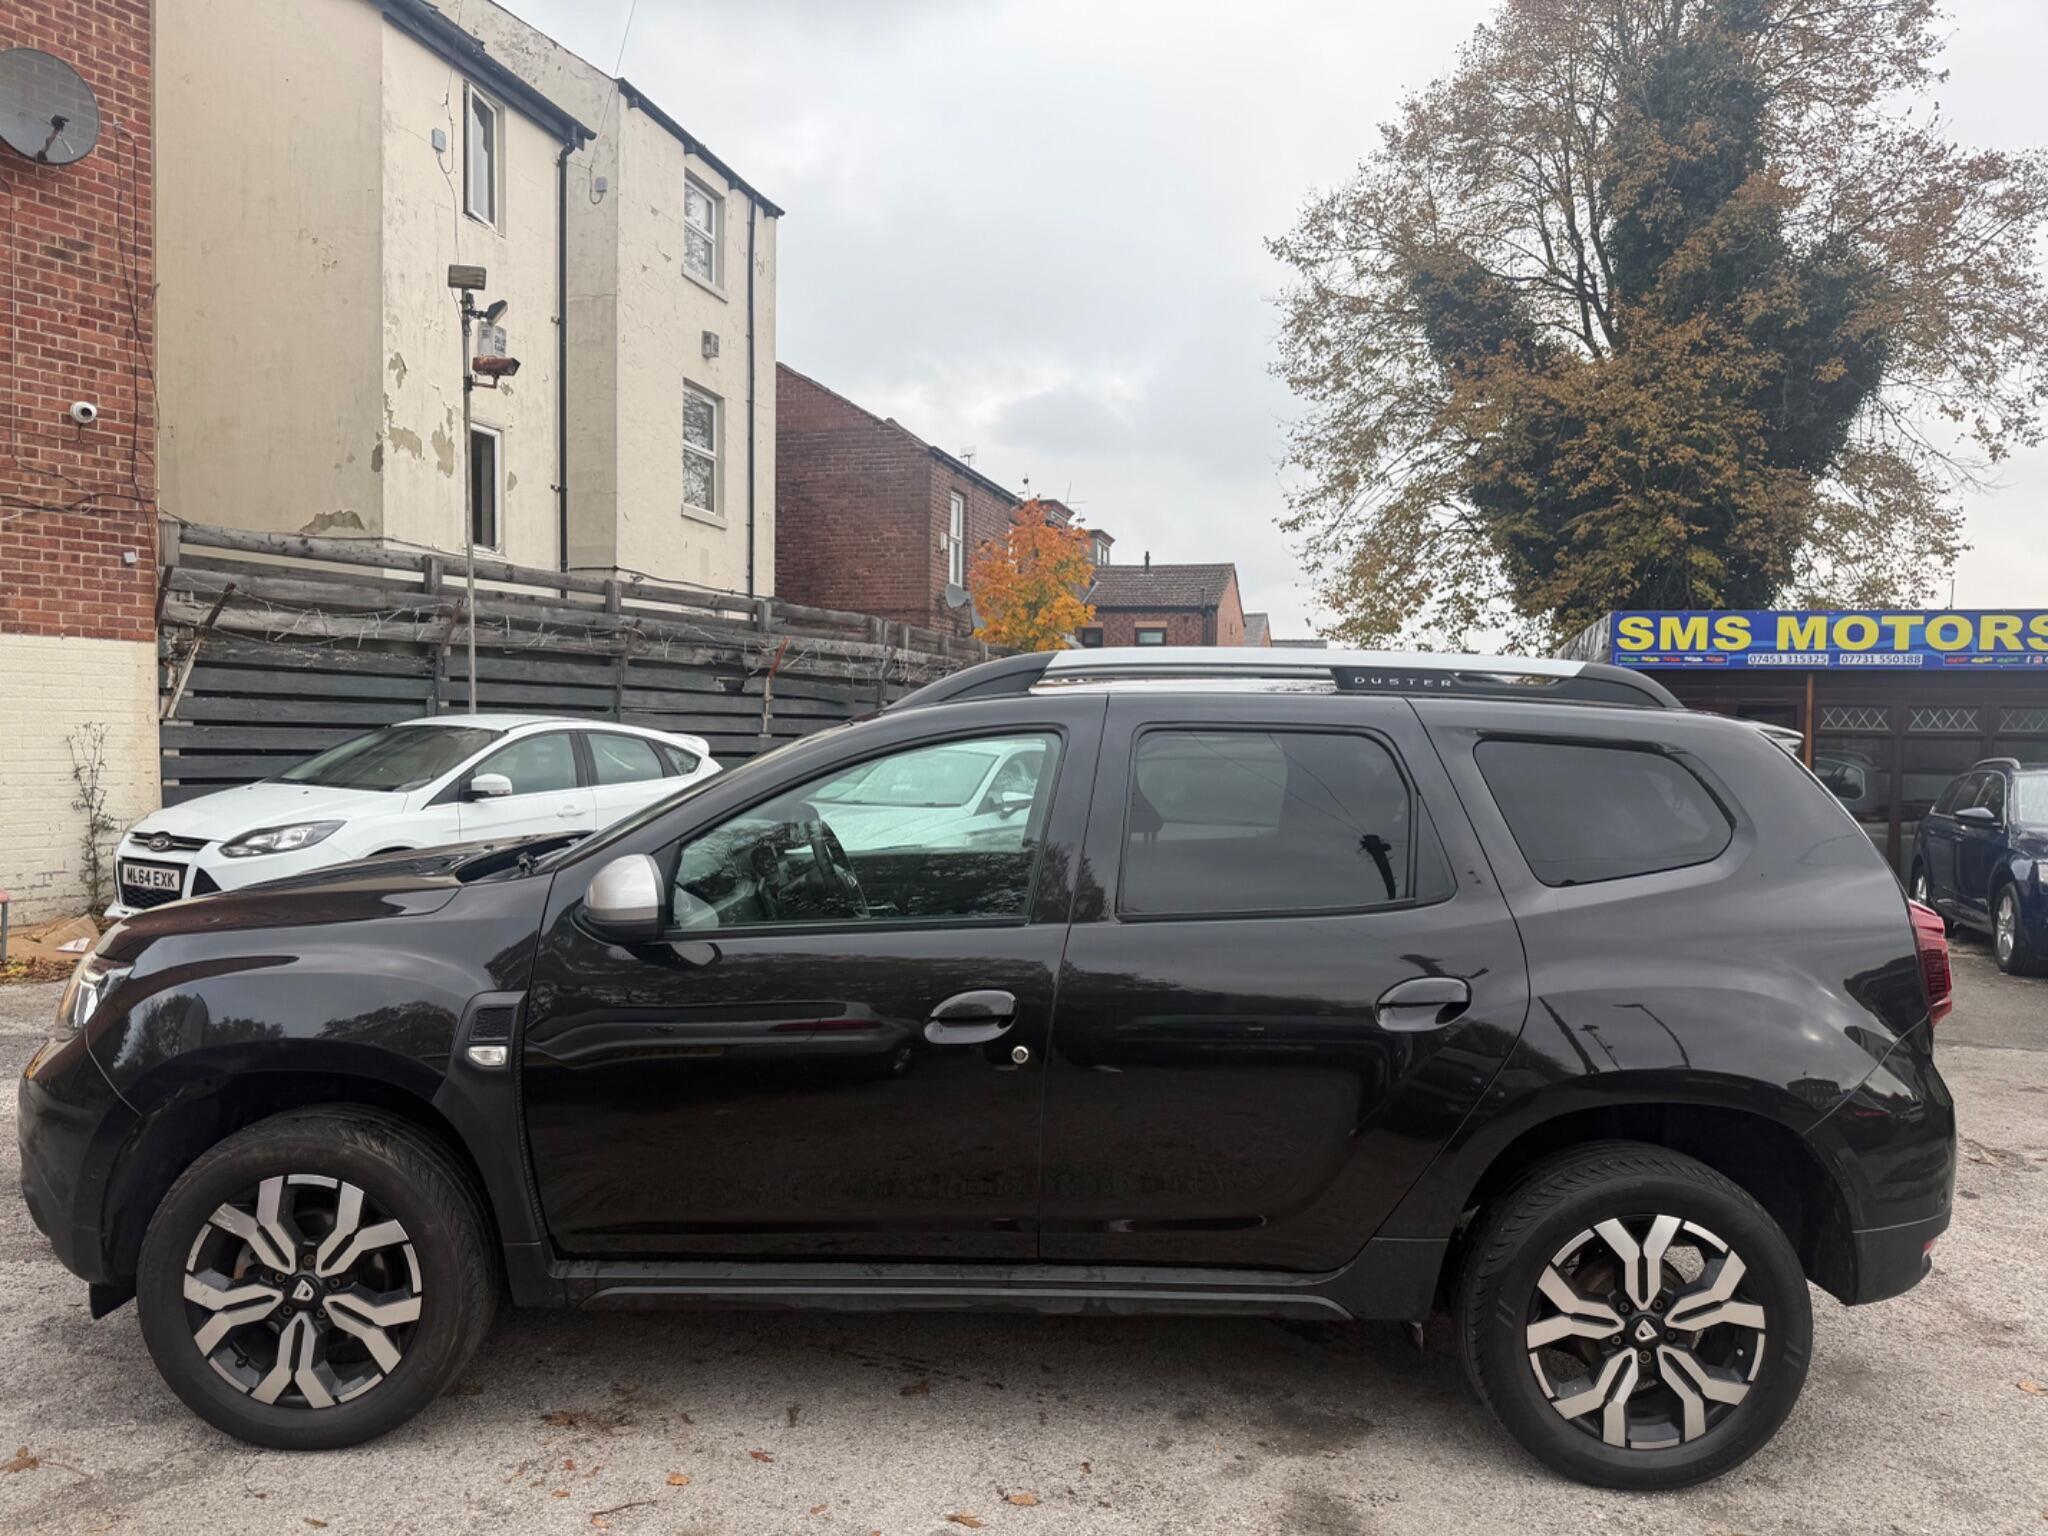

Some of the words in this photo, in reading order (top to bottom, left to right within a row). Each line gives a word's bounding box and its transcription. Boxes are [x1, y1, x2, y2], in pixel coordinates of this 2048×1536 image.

[1616, 615, 1752, 651] SMS
[1776, 614, 2048, 651] MOTORS
[1354, 676, 1452, 688] DUSTER
[127, 867, 150, 885] ML64
[153, 871, 175, 888] EXK
